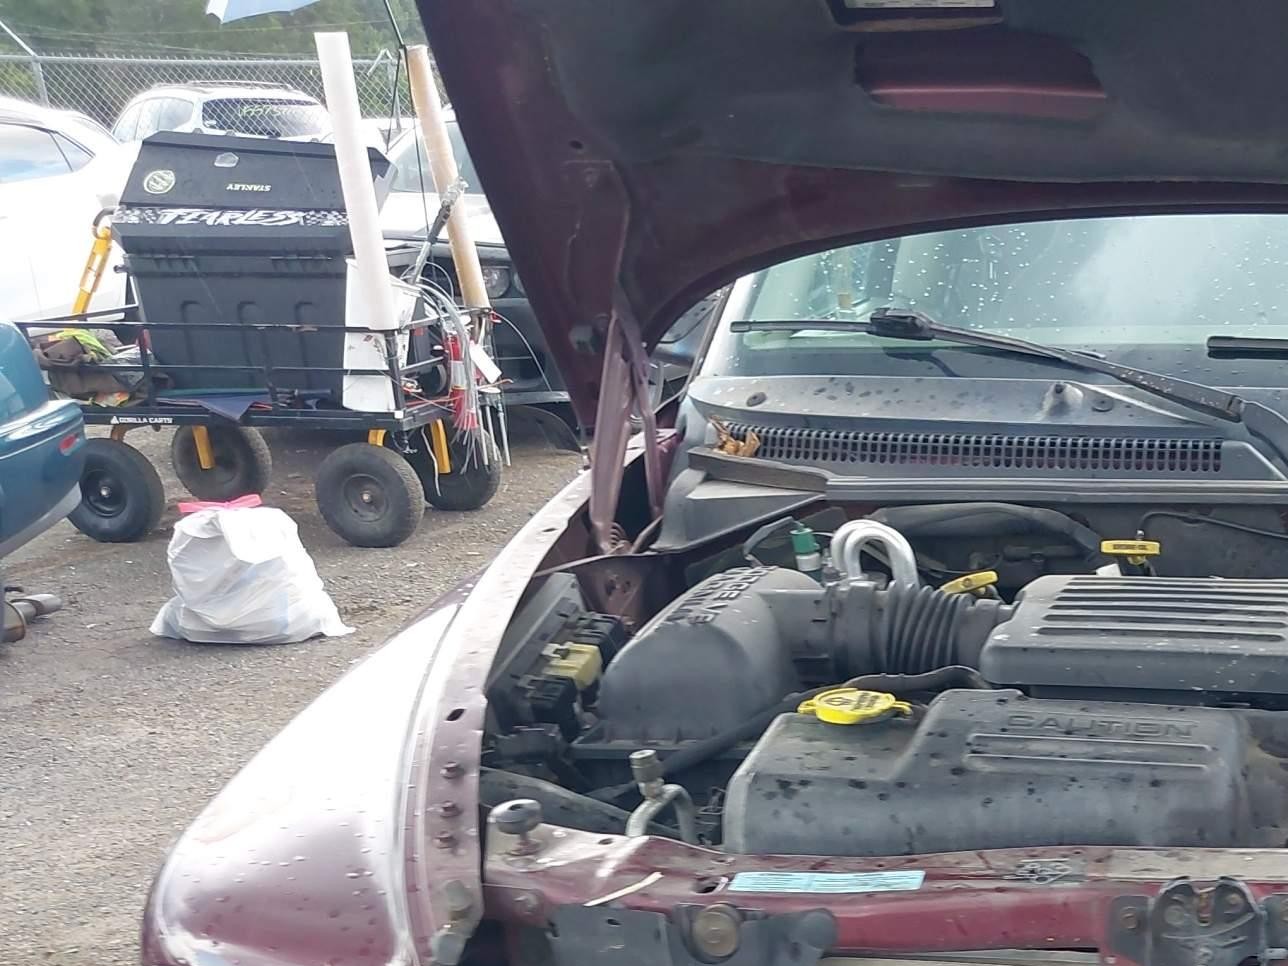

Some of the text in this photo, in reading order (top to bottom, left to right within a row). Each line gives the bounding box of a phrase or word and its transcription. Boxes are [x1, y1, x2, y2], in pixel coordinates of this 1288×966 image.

[226, 183, 272, 192] STANLEY
[157, 207, 306, 227] FEARLESS
[1006, 713, 1198, 740] CAUTION
